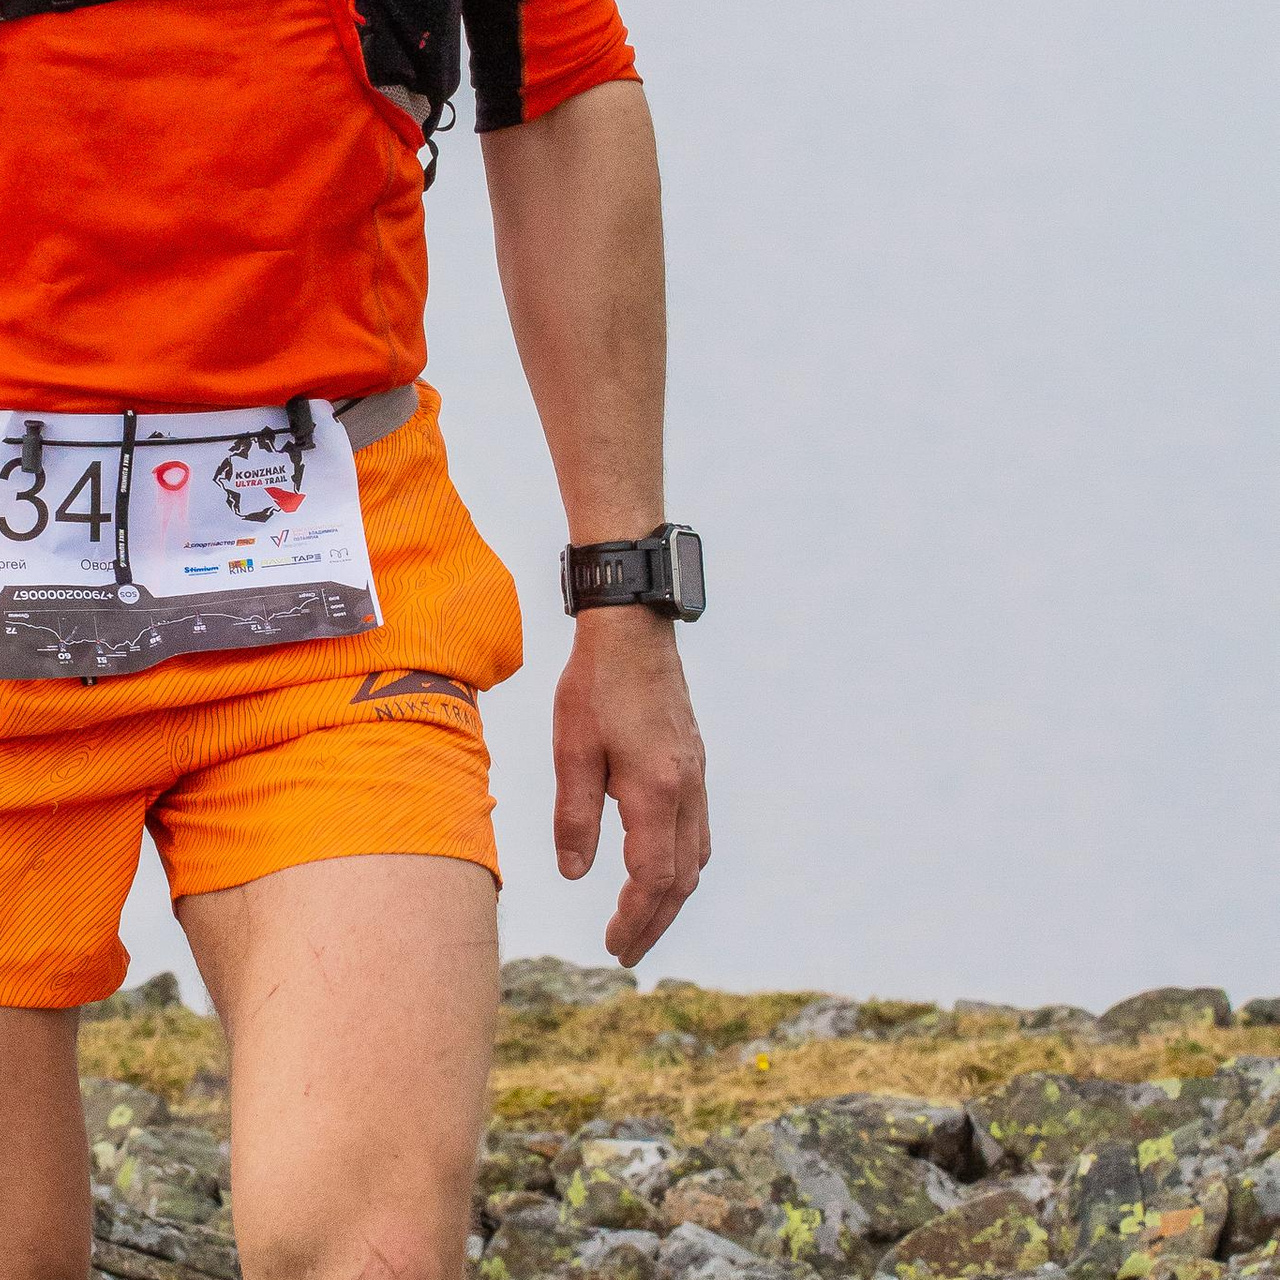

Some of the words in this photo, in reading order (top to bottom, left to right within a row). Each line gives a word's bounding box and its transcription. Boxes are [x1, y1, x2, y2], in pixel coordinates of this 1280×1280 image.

[122, 453, 130, 467] NIKE
[235, 465, 287, 479] KONZHAK
[121, 467, 129, 493] RUNNING
[235, 480, 263, 488] ULTRA
[265, 475, 288, 485] TRAIL
[184, 566, 219, 574] Stimium
[229, 566, 255, 575] KIND
[13, 590, 115, 601] +79002000067
[119, 591, 139, 599] SOS
[5, 626, 18, 635] 72
[57, 652, 72, 661] 60
[374, 700, 437, 720] NIKE
